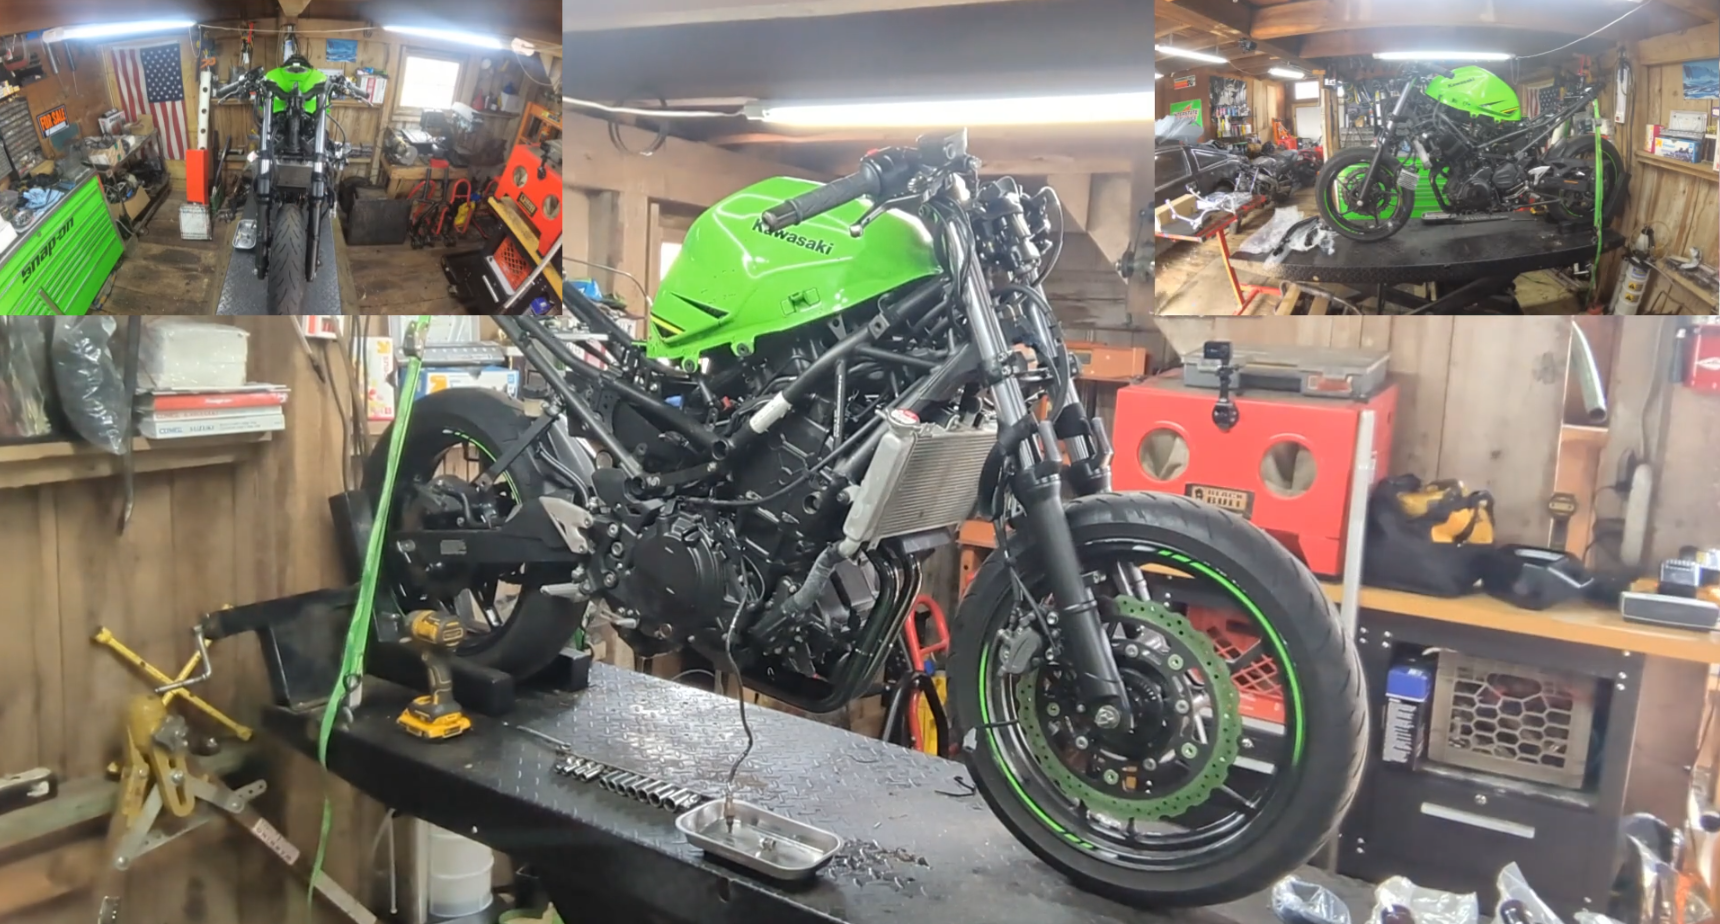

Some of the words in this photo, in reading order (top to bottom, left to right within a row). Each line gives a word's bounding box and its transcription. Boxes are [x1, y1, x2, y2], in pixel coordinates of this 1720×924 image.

[1447, 76, 1475, 88] Kawasaki
[39, 113, 54, 132] FOR
[52, 107, 66, 126] SALE
[752, 218, 834, 255] Kawasaki
[189, 424, 215, 432] SUZUKI
